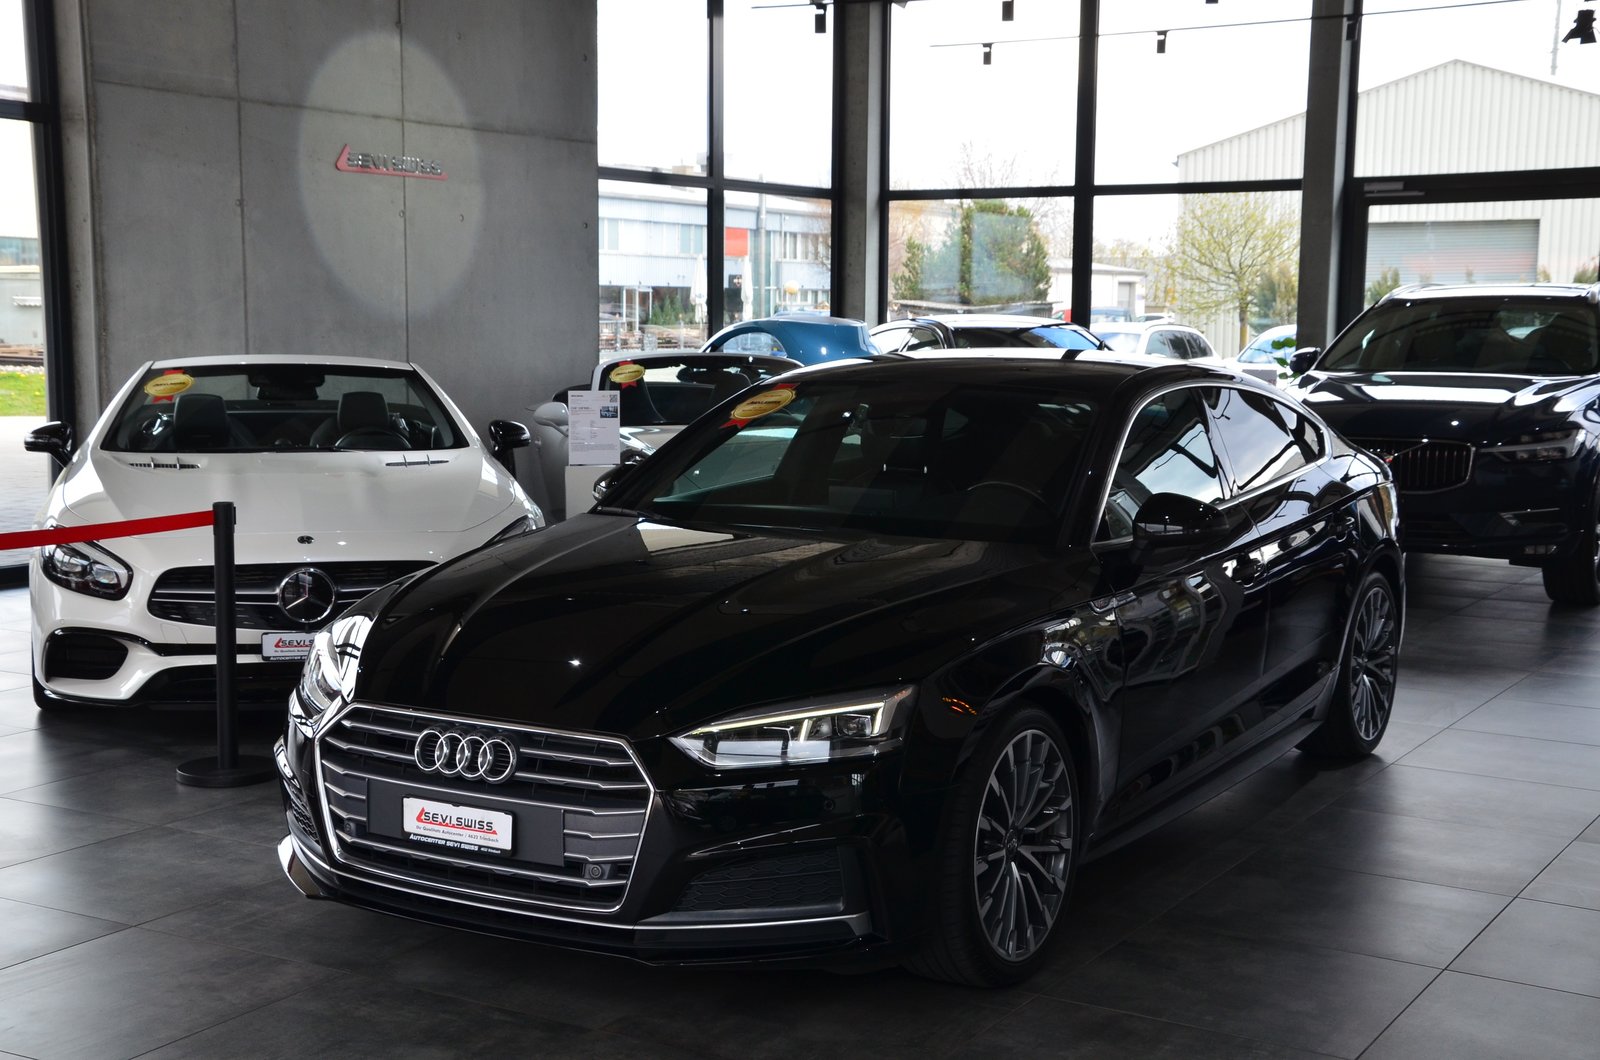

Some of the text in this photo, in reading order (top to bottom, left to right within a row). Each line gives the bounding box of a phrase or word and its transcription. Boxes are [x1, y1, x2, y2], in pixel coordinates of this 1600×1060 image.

[347, 152, 442, 175] SEVI SWISS
[281, 639, 305, 647] SEVI
[423, 811, 494, 831] SEVI SWISS
